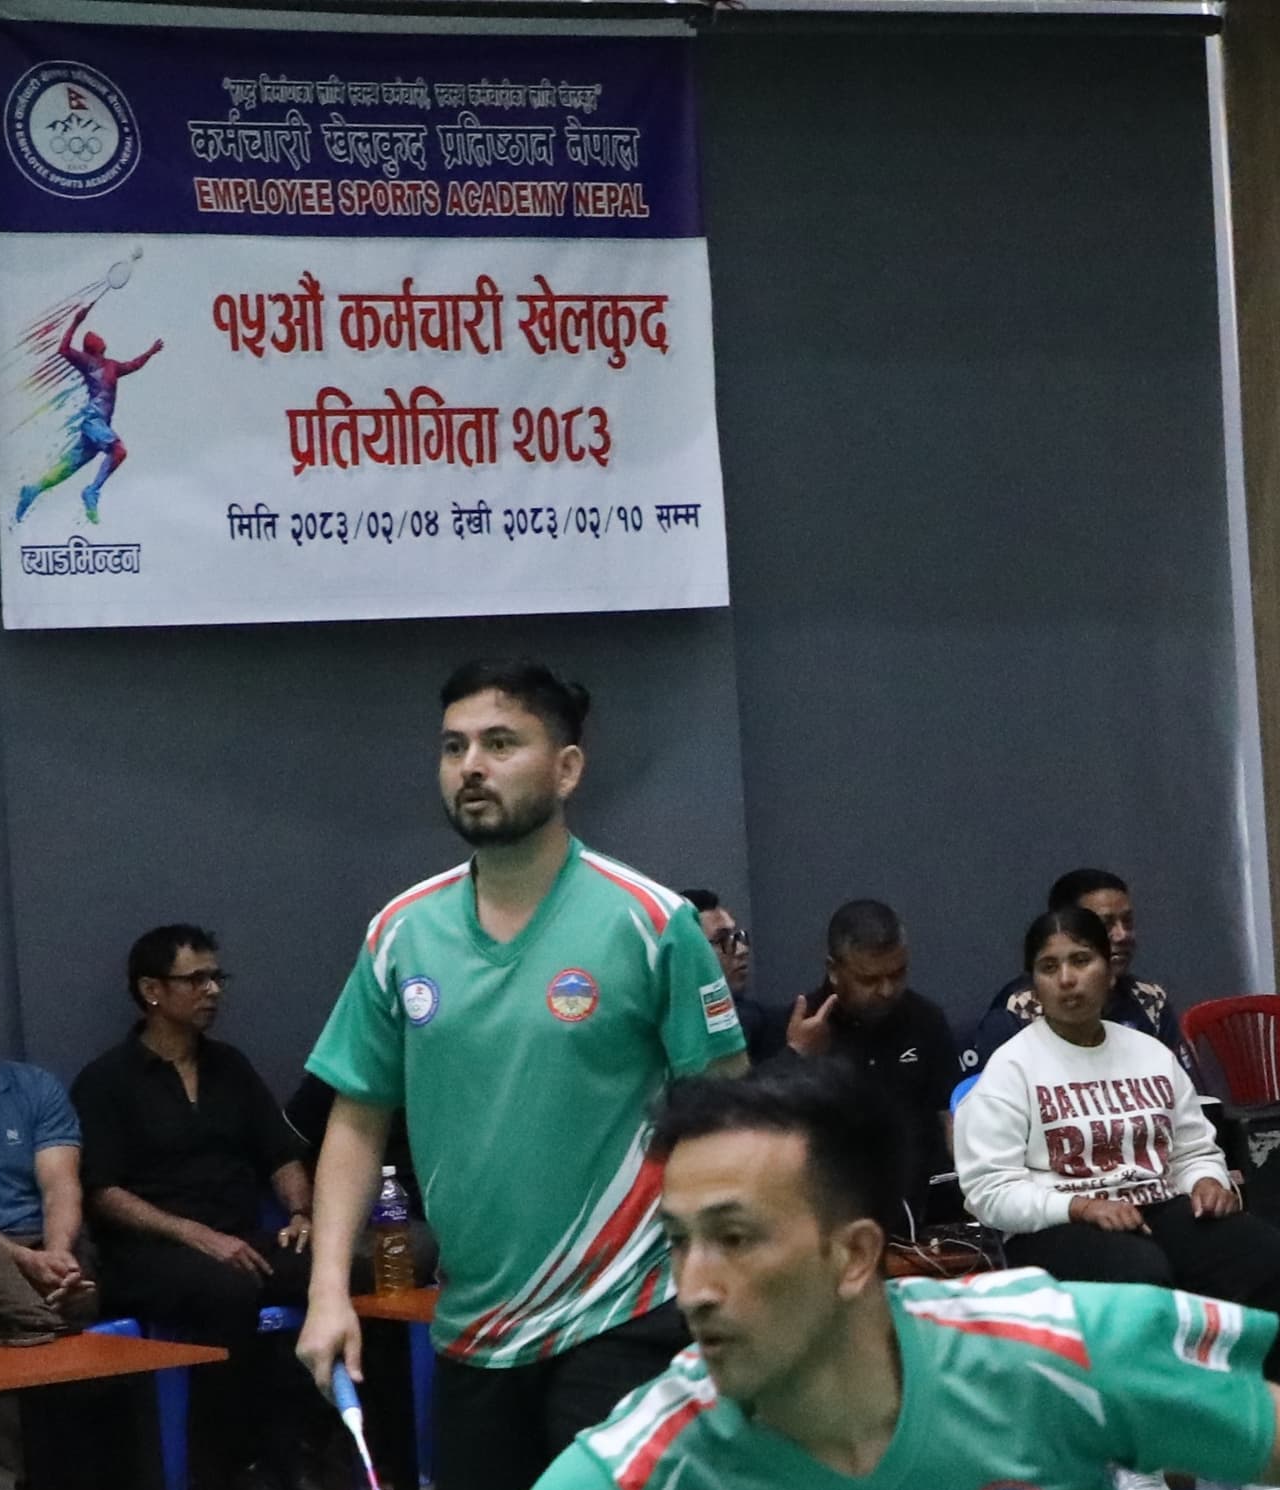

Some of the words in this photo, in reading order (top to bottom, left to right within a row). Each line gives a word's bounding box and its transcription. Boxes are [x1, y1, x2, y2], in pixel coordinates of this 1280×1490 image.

[188, 110, 311, 170] कर्मचारी
[321, 112, 427, 178] खेलकुद
[437, 111, 555, 170] प्रतिष्ठान
[564, 115, 639, 169] नेपाल
[194, 177, 334, 215] EMPLOYEE
[338, 179, 440, 216] SPORTS
[446, 181, 569, 217] ACADEMY
[573, 183, 650, 217] NEPAL
[338, 274, 503, 354] कर्मचारी
[517, 274, 669, 369] खेलकुद
[286, 386, 499, 476] प्रतियोगिता
[513, 406, 612, 466] २०८३
[227, 503, 279, 540] मिति
[291, 509, 439, 546] २०८३/०२/०४
[451, 500, 492, 540] देखी
[503, 503, 643, 543] २०८३/०२/१०
[655, 503, 701, 533] सम्म
